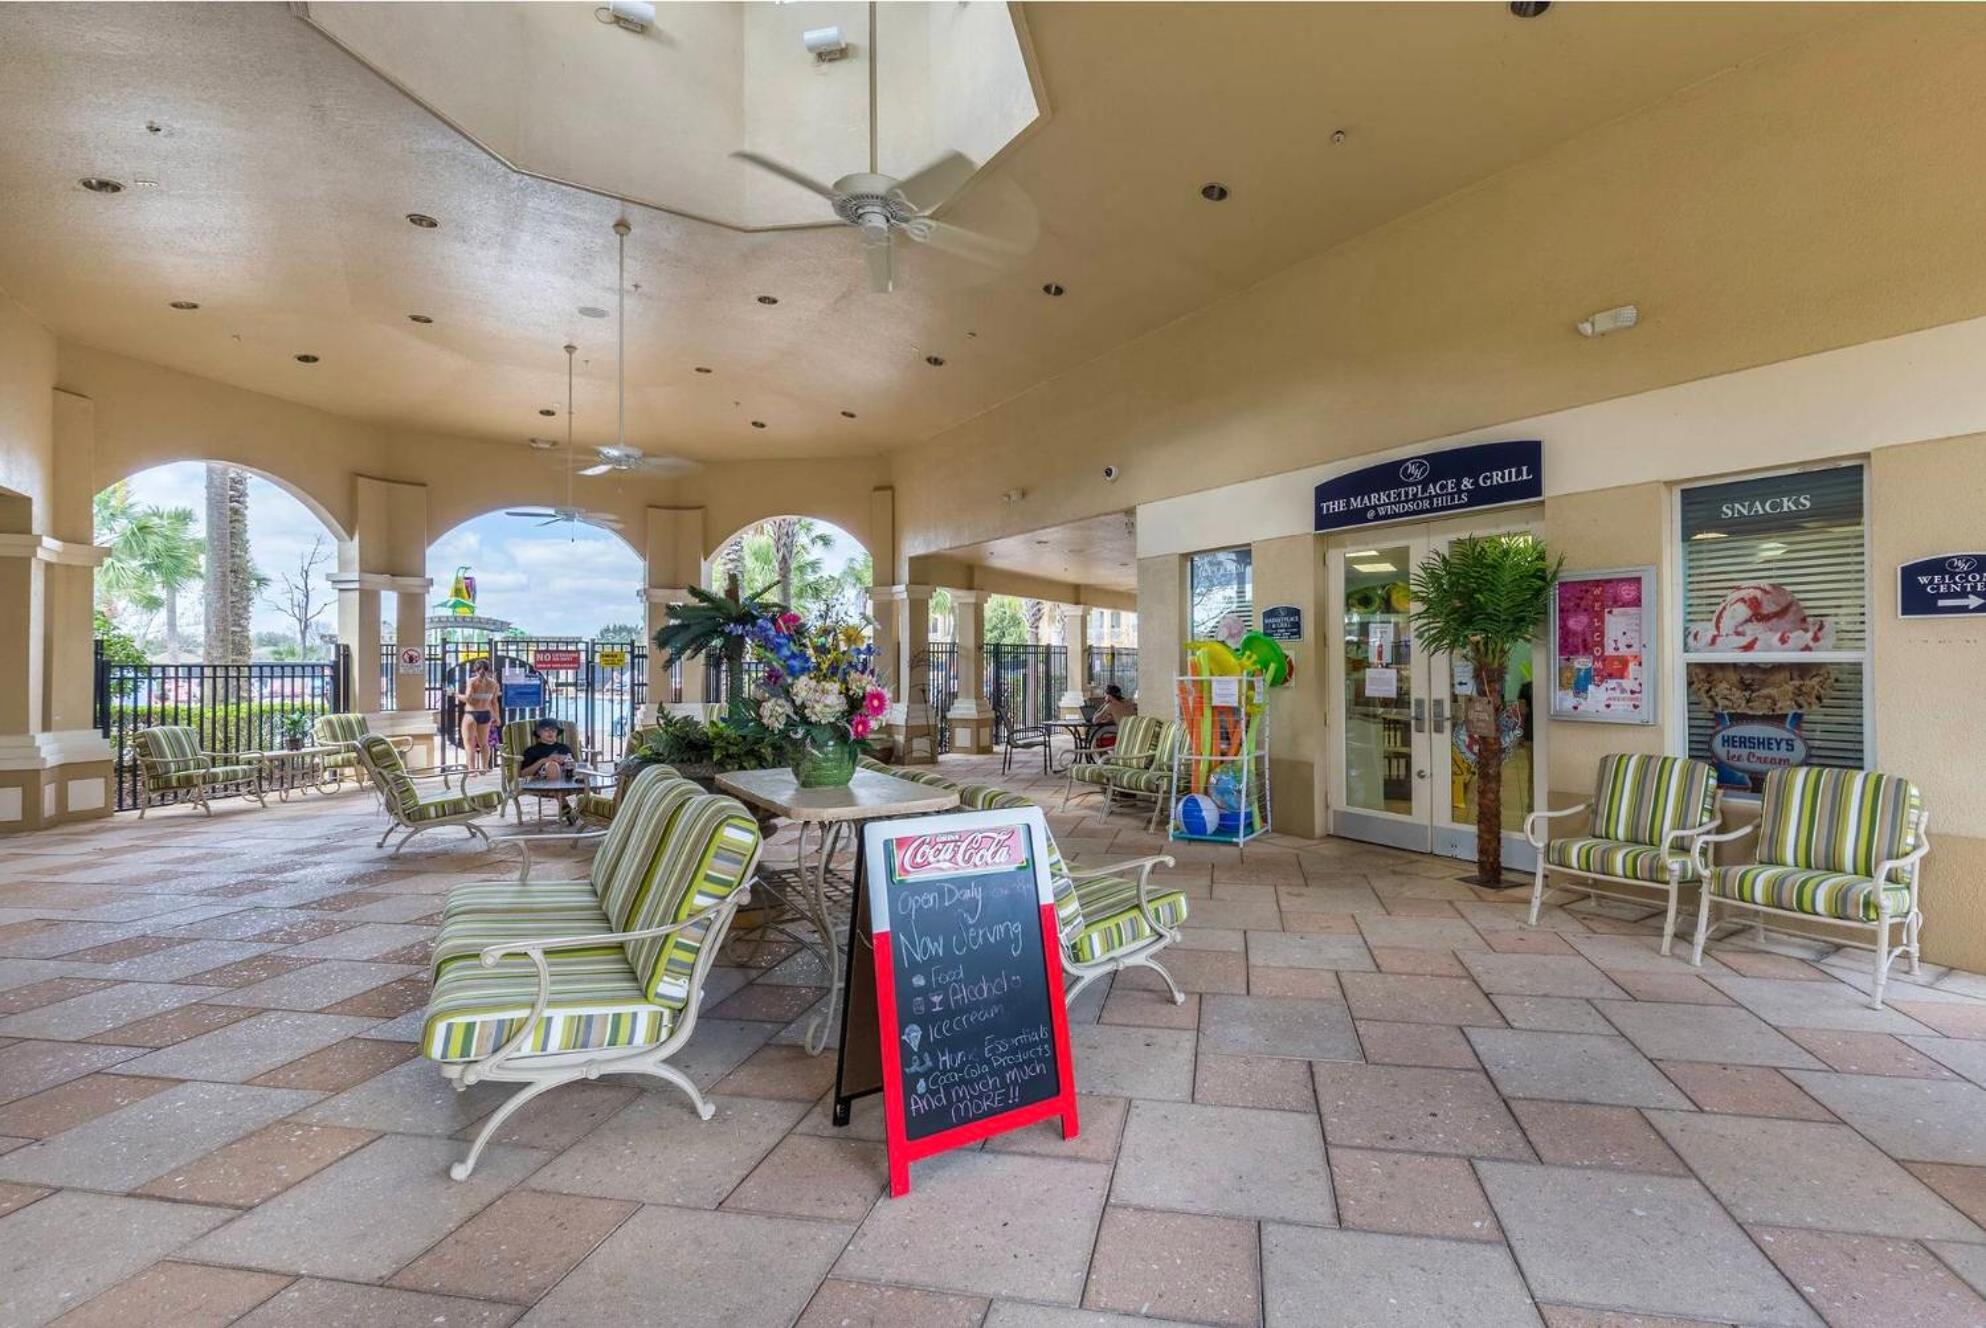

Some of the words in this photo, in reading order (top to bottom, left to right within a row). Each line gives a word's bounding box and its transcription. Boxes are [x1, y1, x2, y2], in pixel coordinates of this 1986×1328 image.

[1320, 498, 1348, 515] THE
[1350, 478, 1457, 509] MARKETPLACE
[1461, 477, 1475, 491] &
[1478, 466, 1533, 487] GRILL
[1366, 508, 1377, 520] @
[1376, 499, 1431, 516] WINDSOR
[1433, 492, 1468, 508] HILLS
[1721, 494, 1811, 519] SNACKS
[1917, 572, 1986, 585] WELCO
[536, 652, 552, 662] NO
[1721, 735, 1795, 752] HERSHEY'S
[1726, 749, 1742, 762] Ice
[1747, 751, 1791, 766] Cream
[898, 890, 938, 920] Open
[936, 881, 982, 924] Daily
[899, 920, 943, 968] Now
[931, 964, 964, 988] Food
[949, 970, 1007, 1009] Alcohol
[910, 1086, 946, 1117] And
